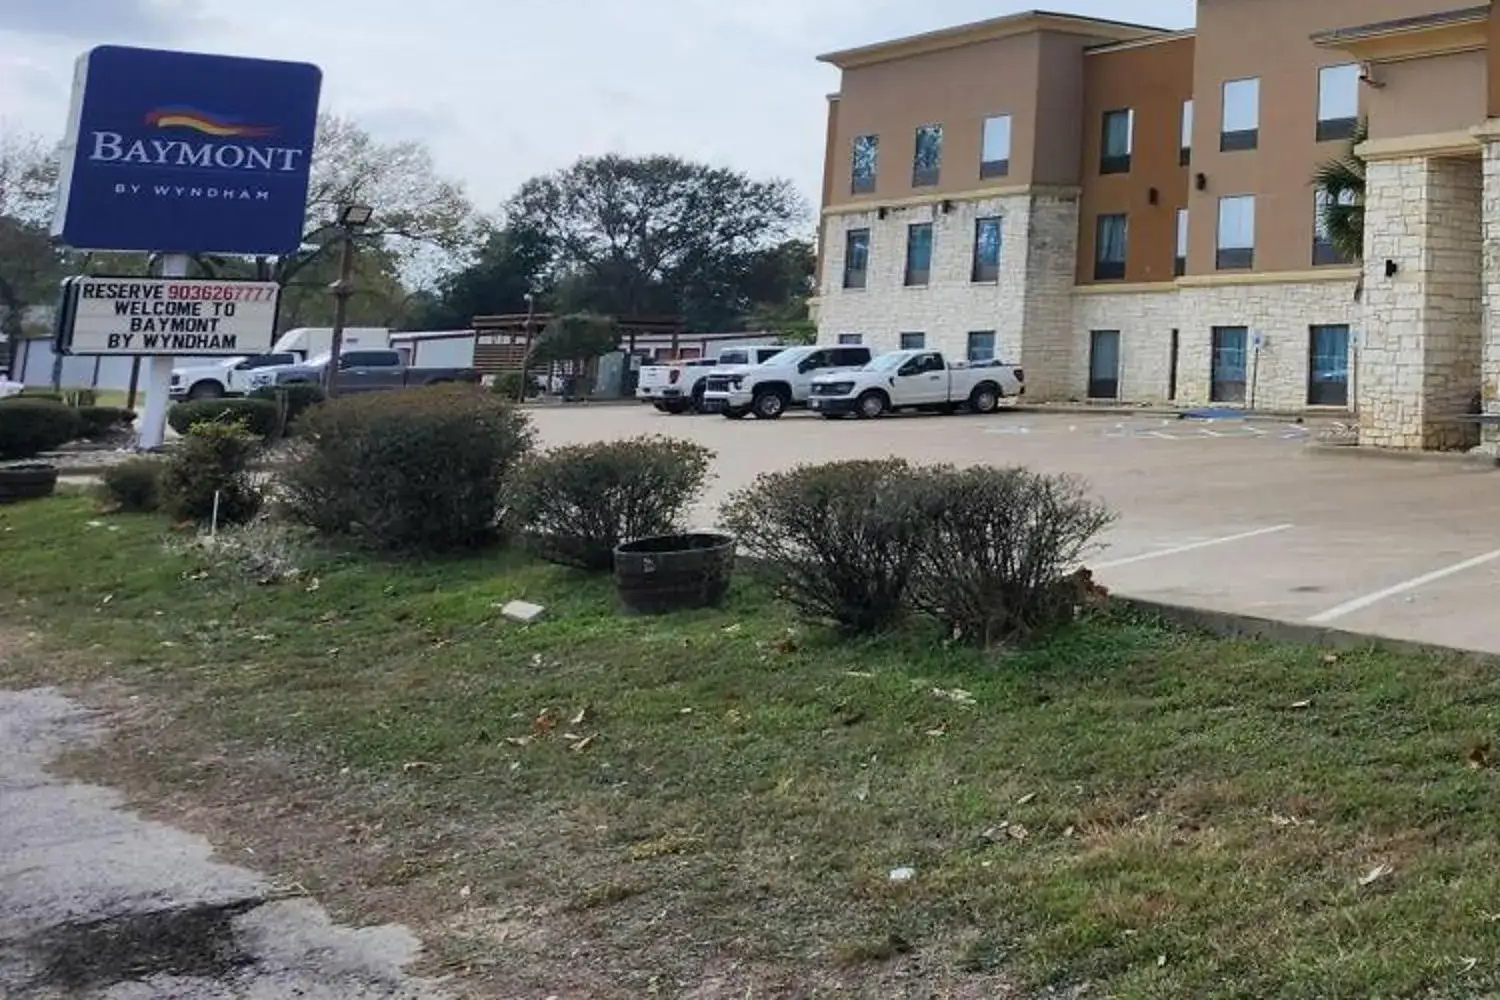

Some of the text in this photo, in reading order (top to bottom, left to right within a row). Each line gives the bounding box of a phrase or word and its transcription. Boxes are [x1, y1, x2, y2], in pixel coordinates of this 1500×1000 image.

[88, 131, 303, 171] BAYMONT
[114, 183, 269, 200] BY WYNDHAM
[83, 283, 275, 301] RESERVE 9036267777
[115, 301, 235, 317] WELCOME TO
[130, 317, 220, 333] BAYMONT
[107, 334, 237, 349] BY WYNDHAM
